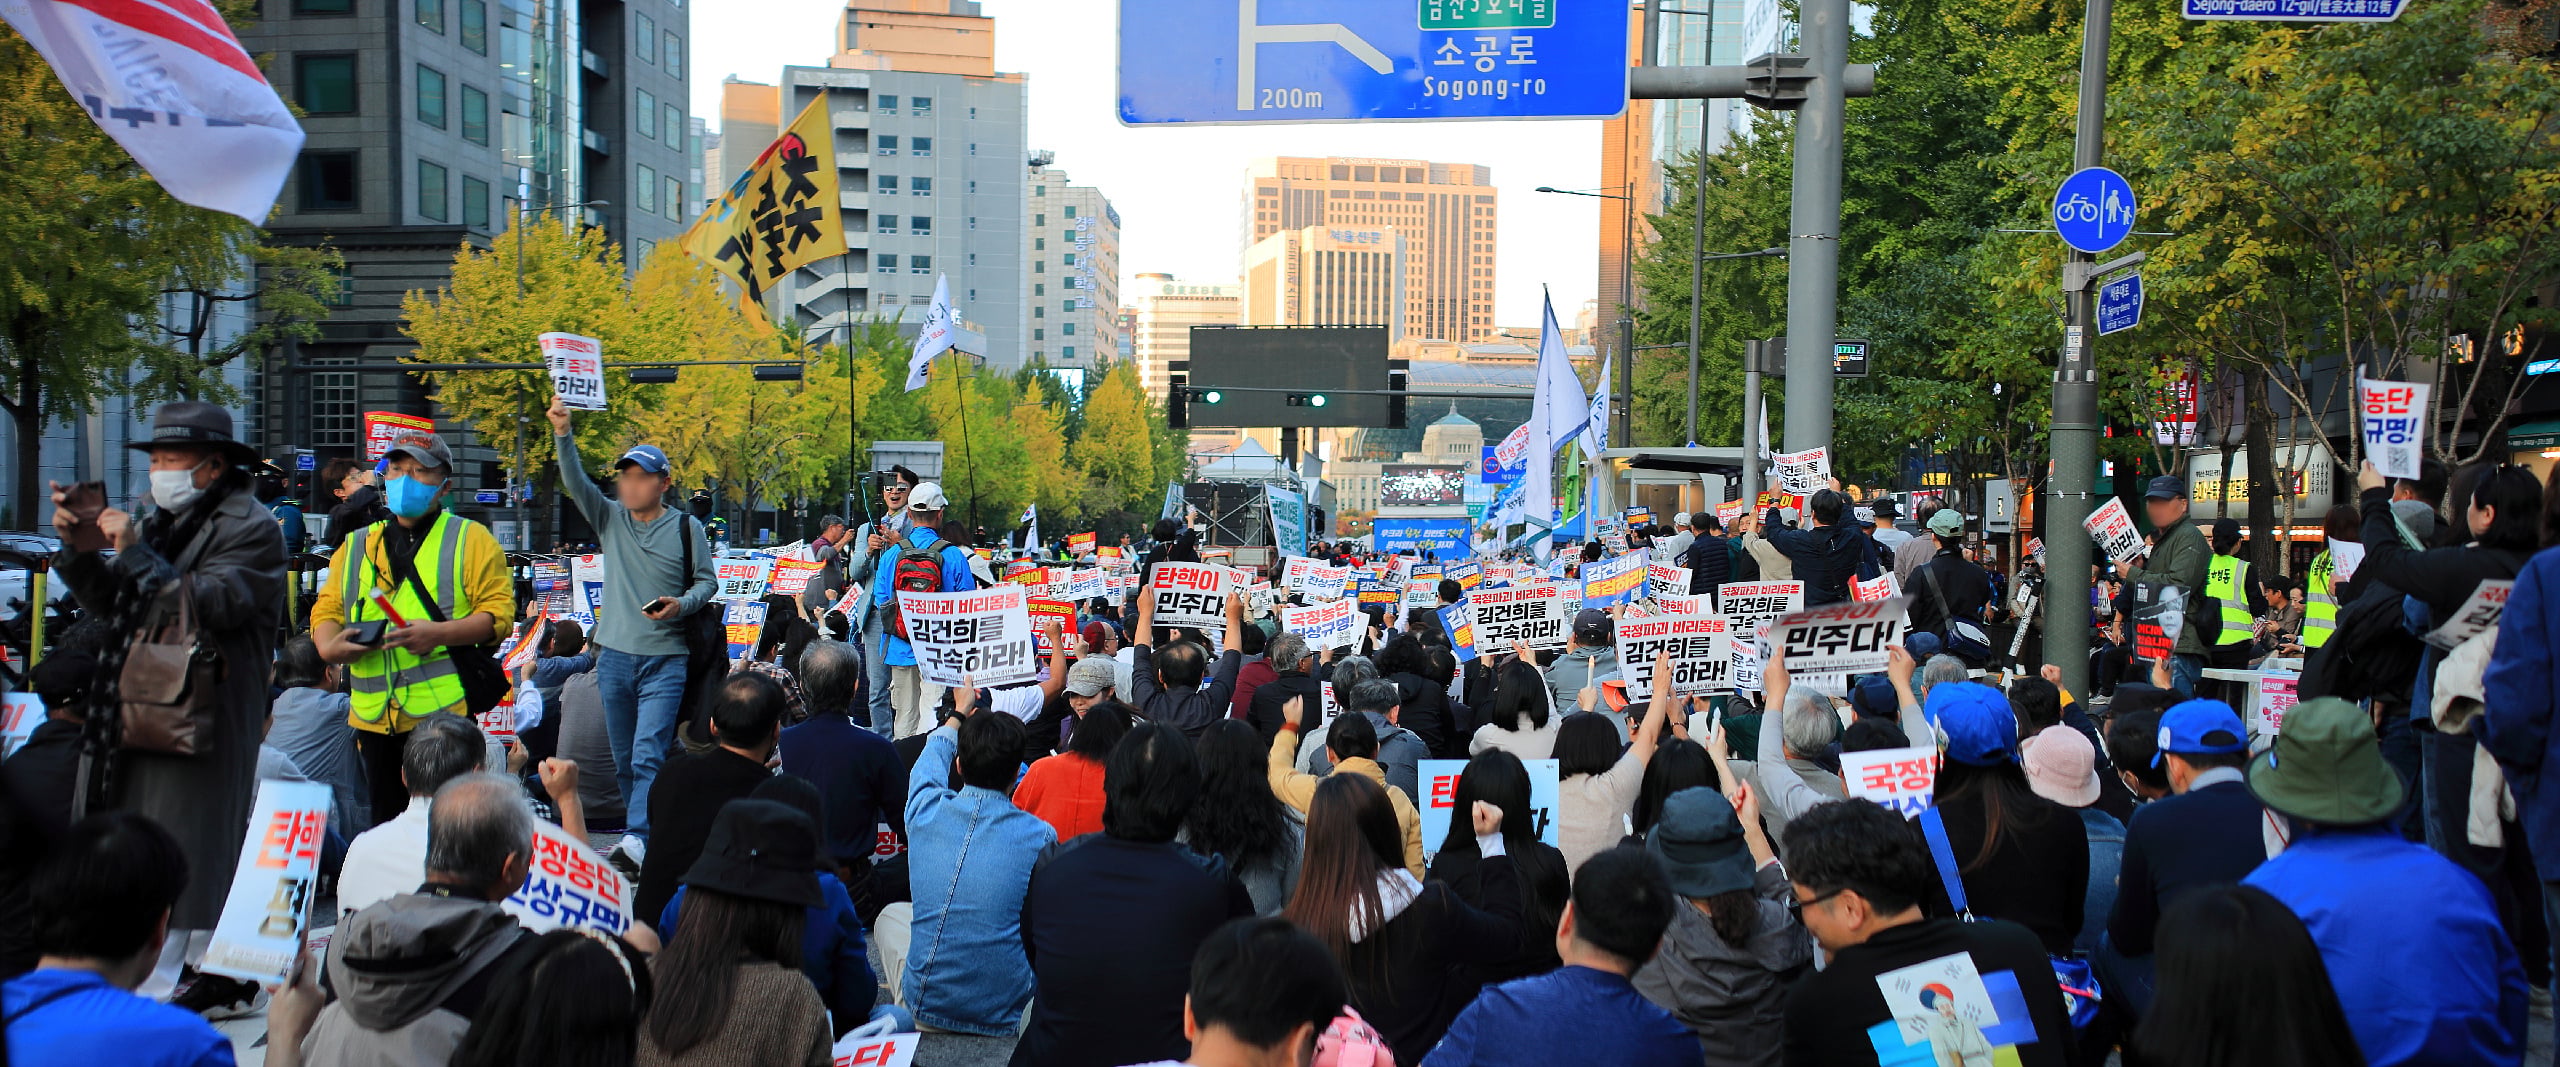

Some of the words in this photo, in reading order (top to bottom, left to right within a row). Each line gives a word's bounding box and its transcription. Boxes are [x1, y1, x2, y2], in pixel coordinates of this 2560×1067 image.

[1433, 36, 1538, 73] 소공로
[1261, 87, 1323, 109] 200m
[1423, 75, 1547, 104] Sogong-ro
[1330, 229, 1382, 244] 서울신문
[2363, 417, 2419, 445] 규명!
[717, 564, 761, 580] 탄핵이
[1445, 564, 1479, 582] 김건희를
[1585, 551, 1644, 580] 김건희를
[1152, 566, 1221, 592] 탄핵이
[1585, 570, 1649, 600] 특검하라!
[1720, 584, 1761, 597] 국정파괴
[1862, 578, 1894, 601] 농단
[903, 596, 955, 616] 국정파괴
[1358, 591, 1400, 603] 특검하라!
[1471, 591, 1514, 606] 국정파괴
[1658, 598, 1700, 615] 탄핵이
[1723, 596, 1789, 614] 김건희를
[1289, 600, 1351, 627] 국정농단
[1477, 600, 1549, 625] 김건희를
[911, 614, 1004, 645] 김건희를
[1290, 613, 1356, 640] 진상규명!
[1485, 618, 1562, 643] 구속하라!
[1618, 620, 1669, 639] 국정파괴
[1671, 618, 1726, 634] 비리몸통
[1784, 619, 1896, 658] 민주다!
[925, 639, 1026, 674] 구속하라!
[1624, 635, 1712, 665] 김건희를
